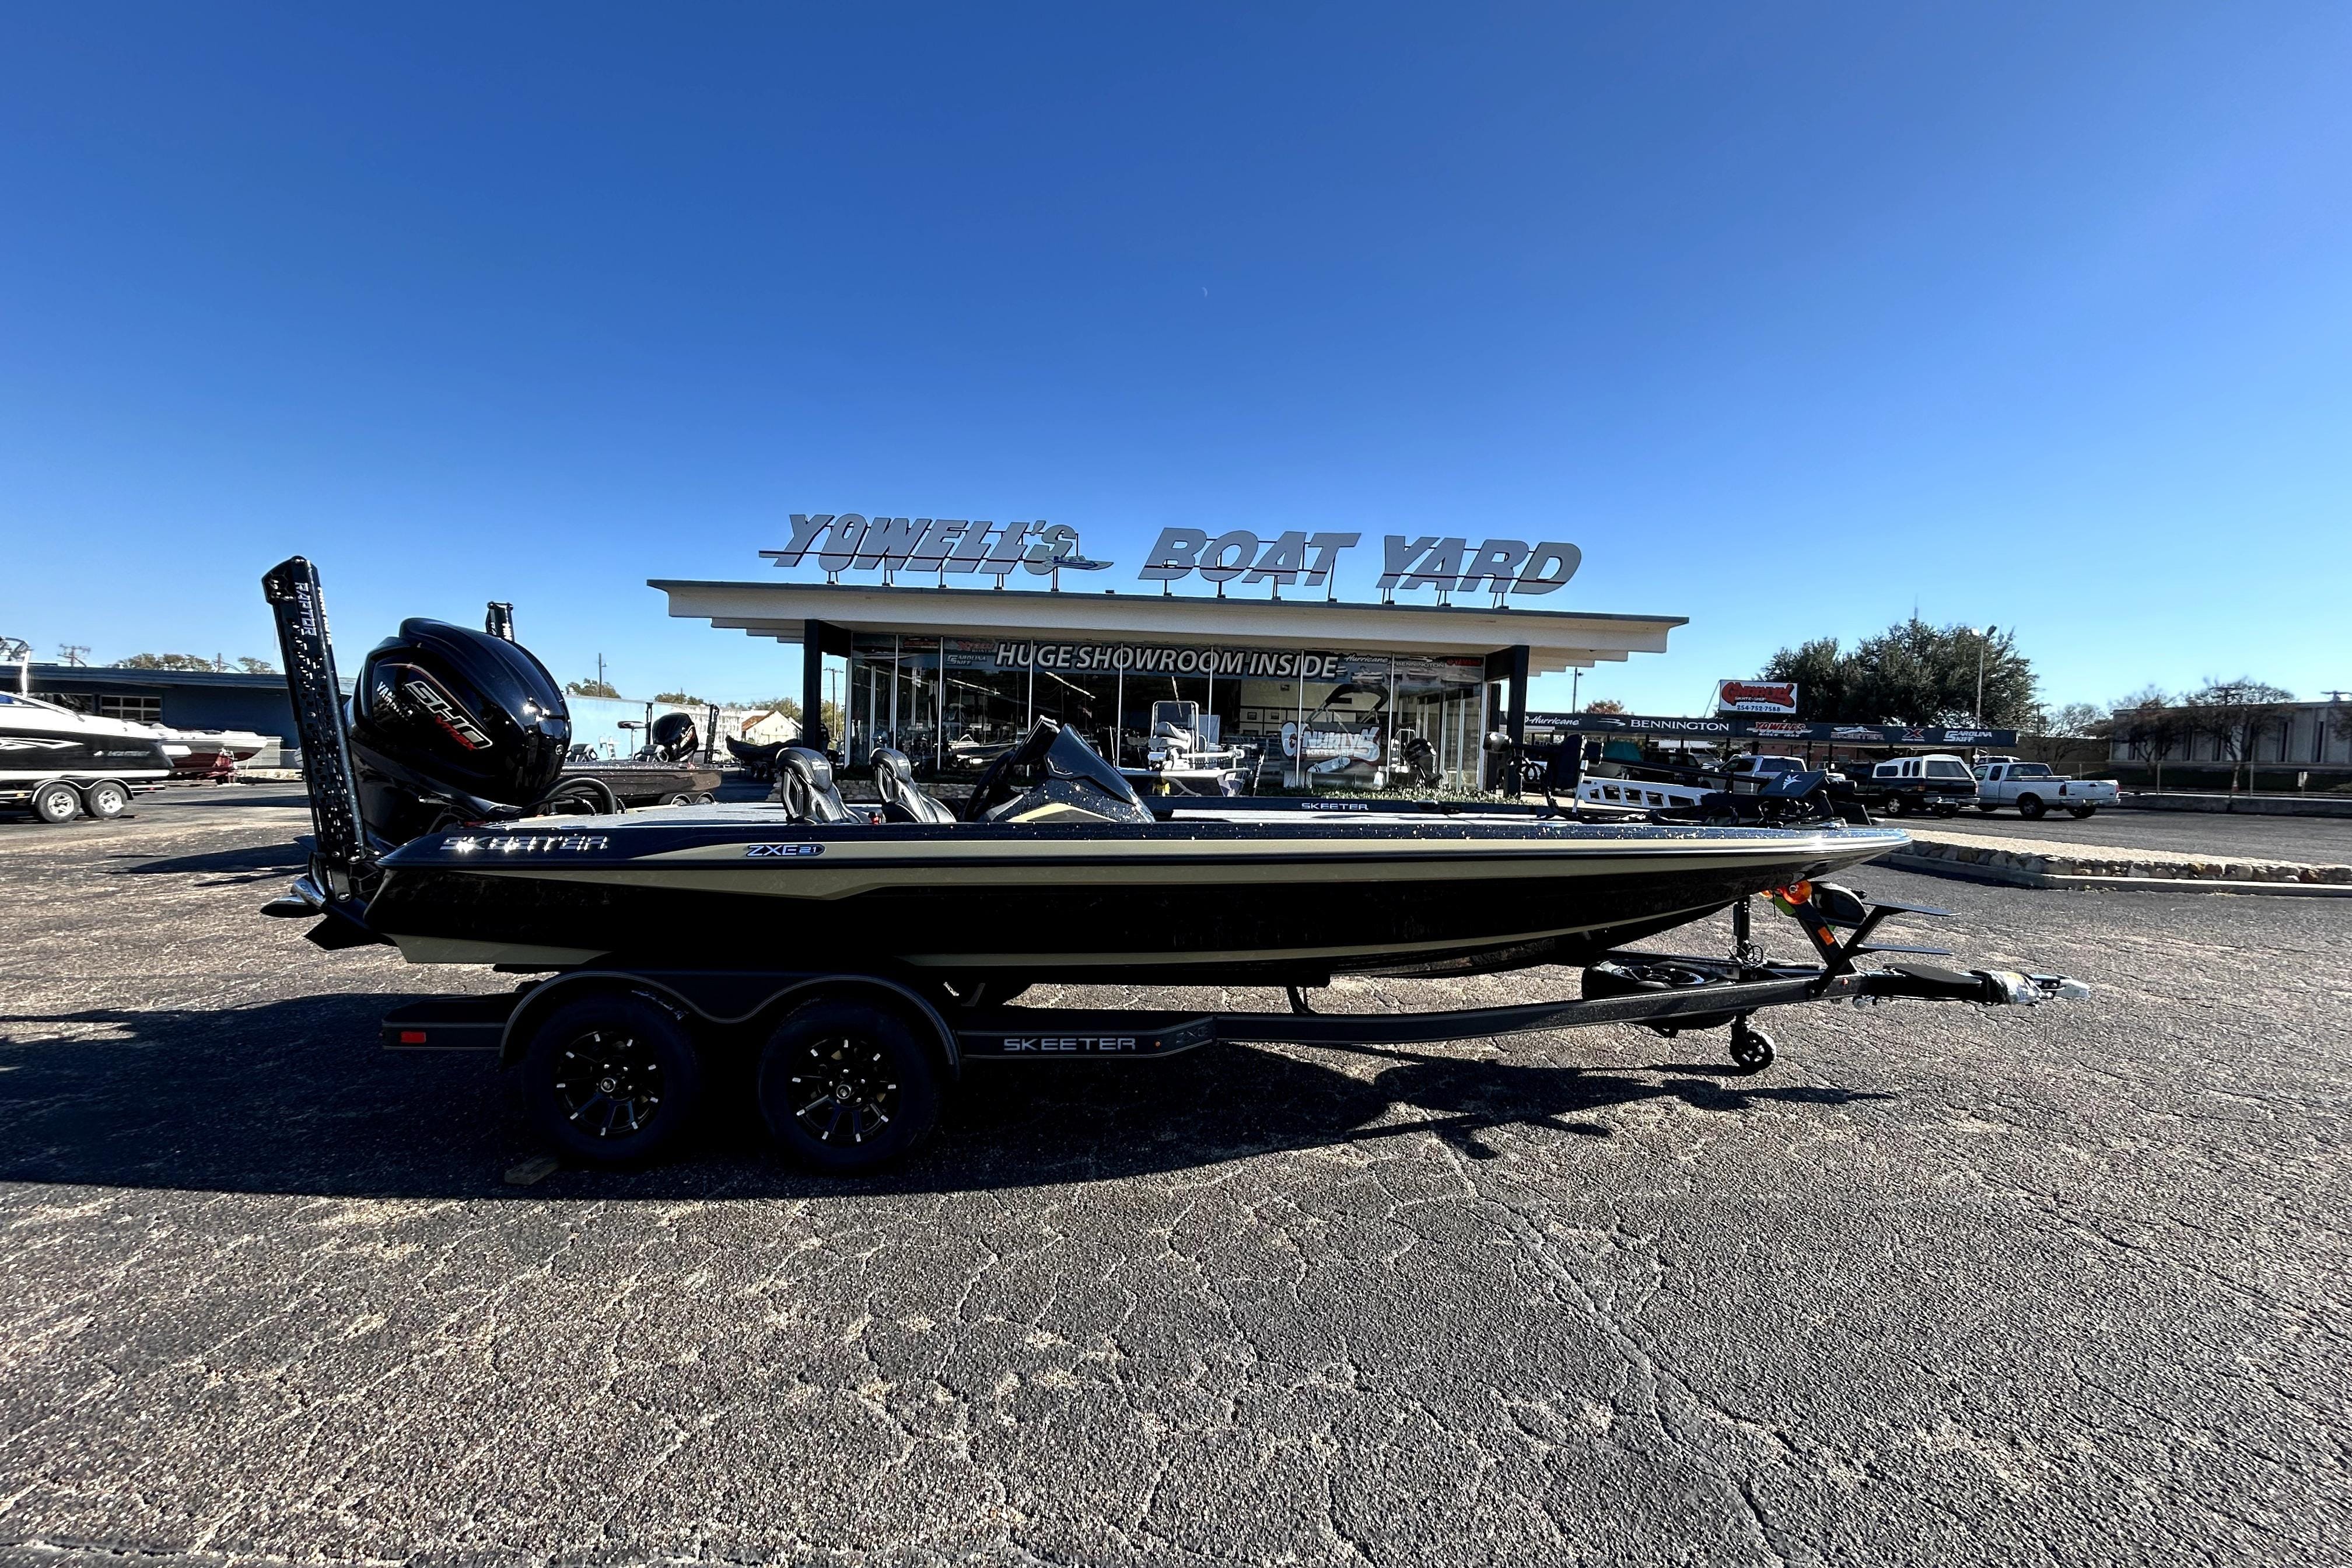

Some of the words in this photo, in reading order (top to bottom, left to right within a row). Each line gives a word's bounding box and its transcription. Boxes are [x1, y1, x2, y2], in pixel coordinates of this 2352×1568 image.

[773, 513, 1076, 575] YOWELL'S
[1138, 527, 1361, 586] BOAT
[1376, 535, 1581, 594] YARD
[295, 582, 317, 636] RAPTOR
[996, 644, 1073, 667] HUGE
[1076, 646, 1243, 675] SHOWROOM
[1247, 653, 1339, 678] INSIDE
[1344, 654, 1389, 663] Hurricane
[404, 681, 492, 749] SHO
[1529, 715, 1580, 726] Hurricane
[1630, 719, 1730, 731] BENNINGTON
[1831, 732, 1885, 740] SKEETER
[1943, 733, 1974, 743] SKIFF
[747, 845, 798, 856] ZXE
[1004, 1038, 1136, 1051] SKEETER
